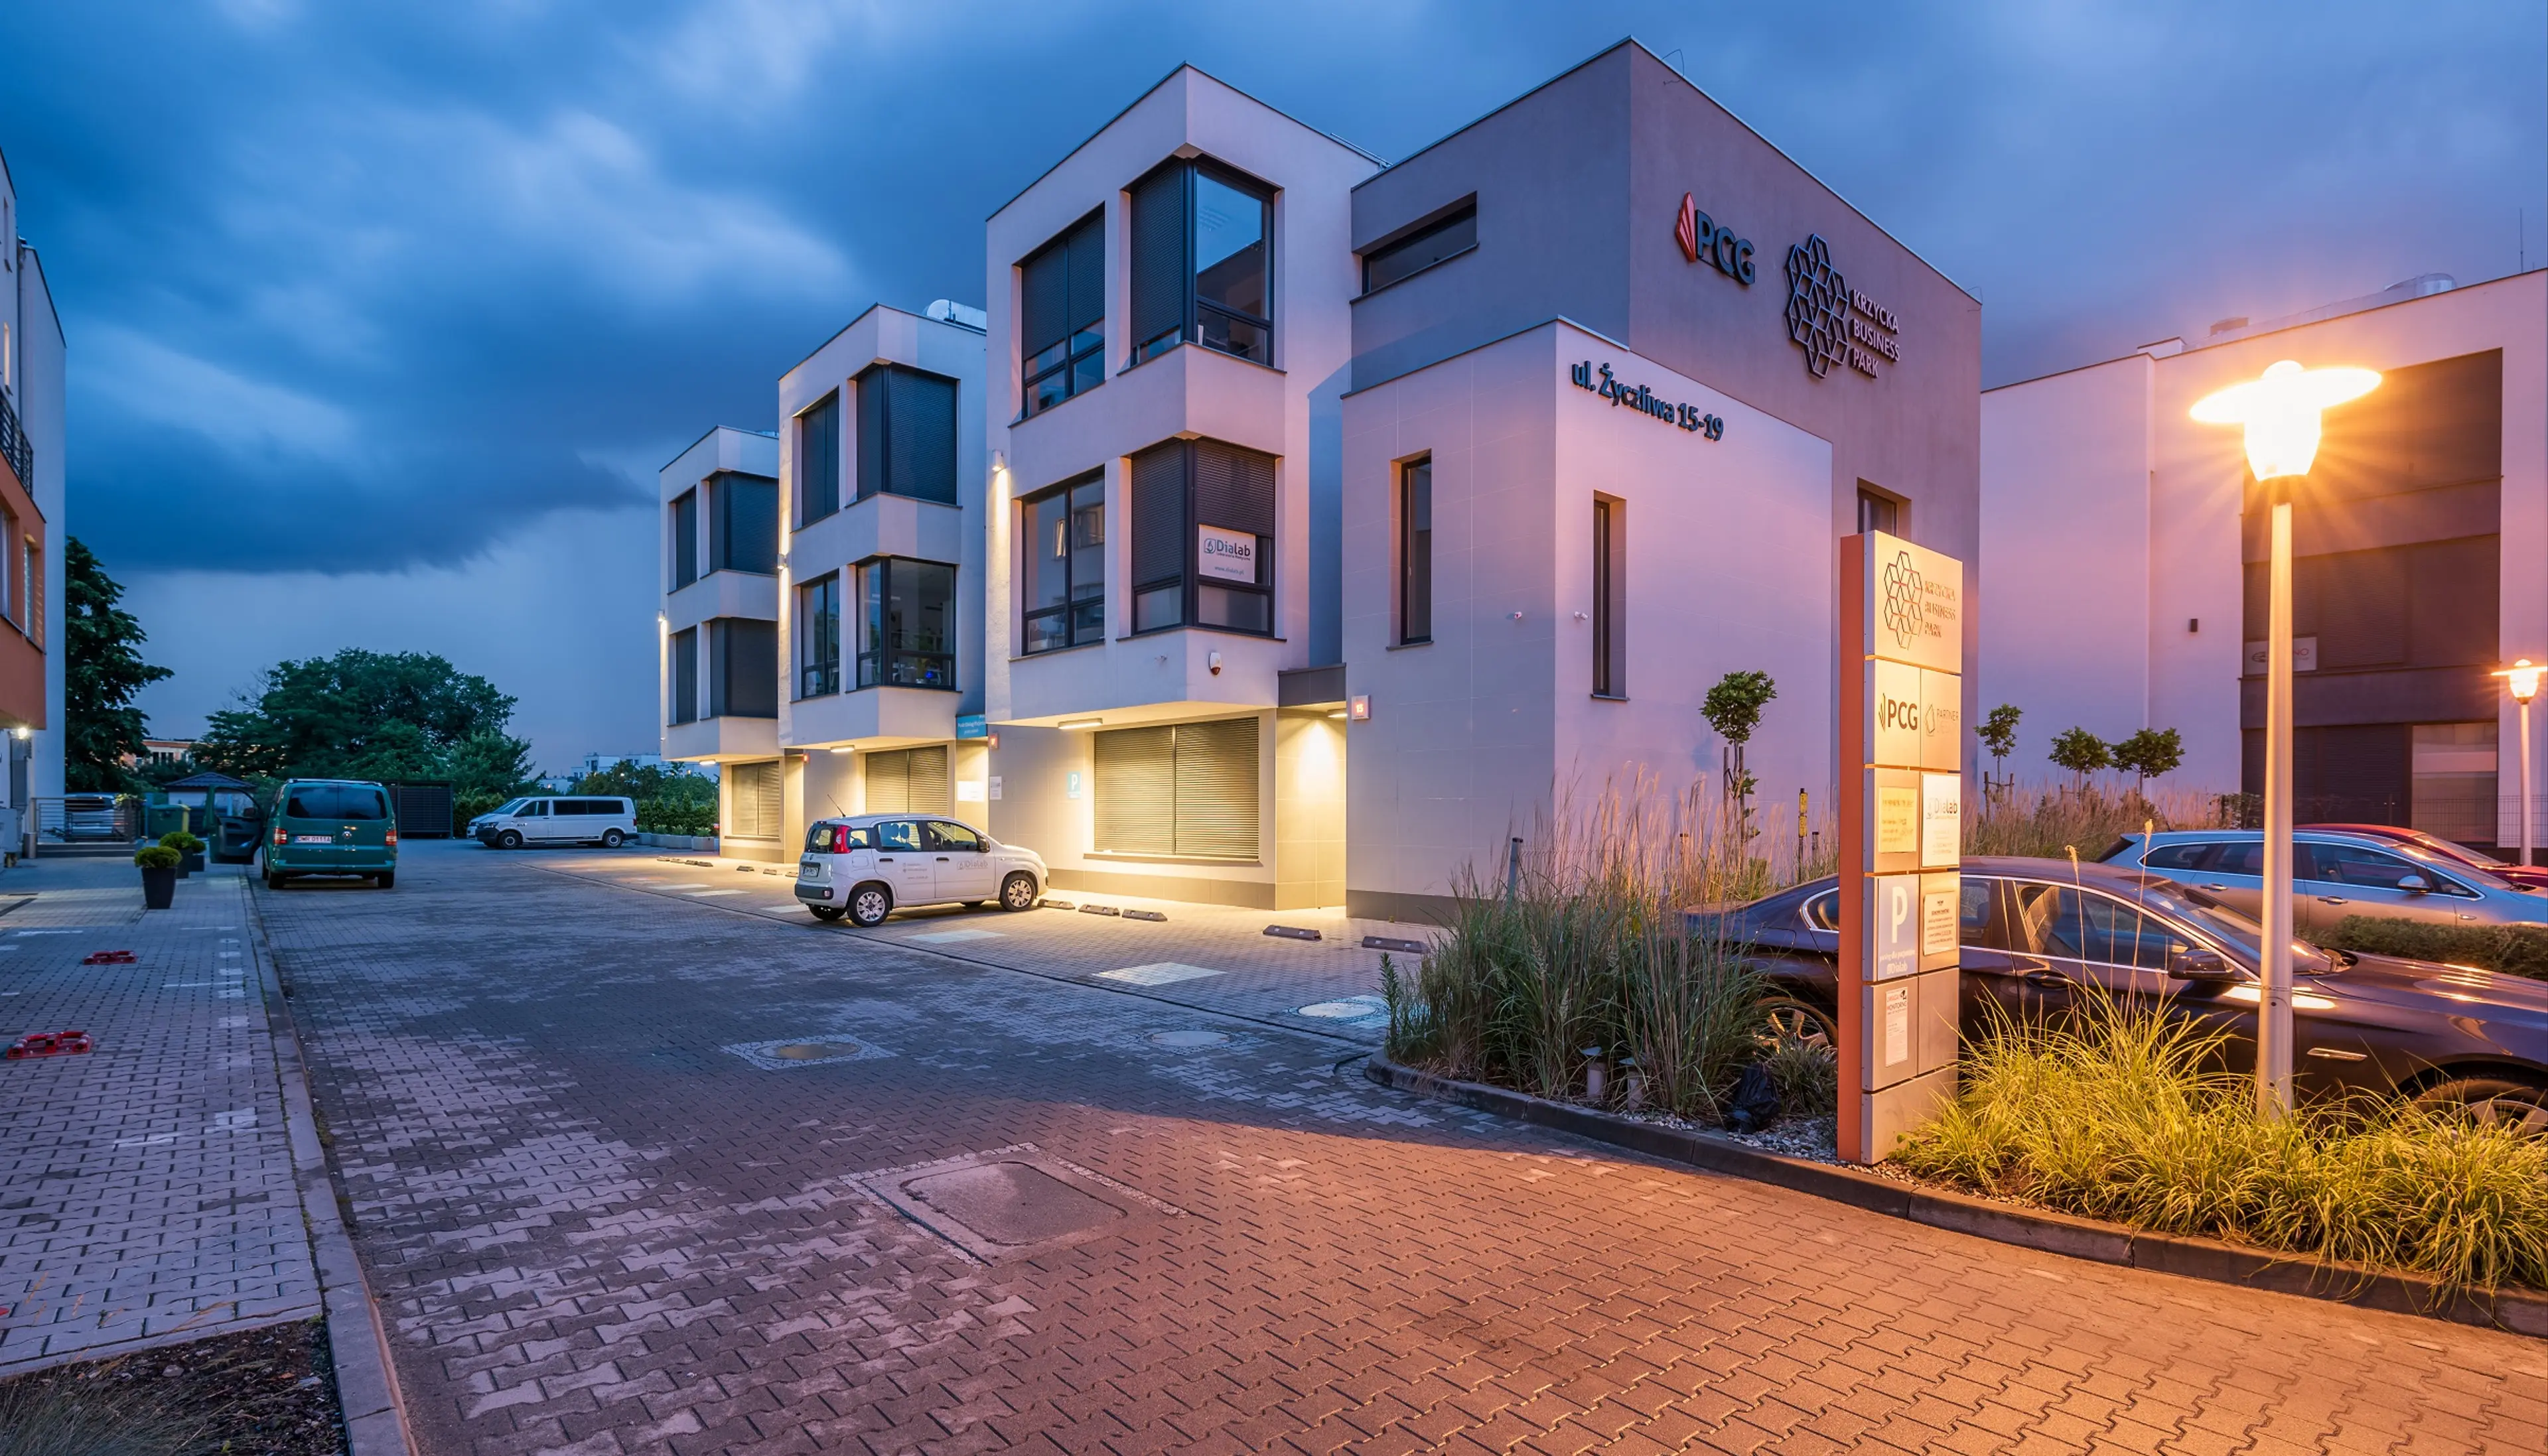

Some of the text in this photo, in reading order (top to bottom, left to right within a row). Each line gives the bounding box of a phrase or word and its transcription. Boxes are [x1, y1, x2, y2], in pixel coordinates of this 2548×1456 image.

[1697, 210, 1755, 285] PCG
[1852, 289, 1899, 334] KRZYCKA
[1852, 318, 1900, 362] BUSINESS
[1851, 348, 1878, 378] PARK
[1572, 360, 1724, 441] ul. Życzliwa 15-19
[1217, 540, 1250, 557] Dialab
[1925, 601, 1956, 621] BUSINESS
[1888, 699, 1918, 730] PCG
[1937, 708, 1959, 721] PARTNER
[1071, 774, 1078, 790] P
[1935, 798, 1957, 815] Dialab
[1892, 886, 1908, 943] P
[1890, 960, 1908, 974] Dialab
